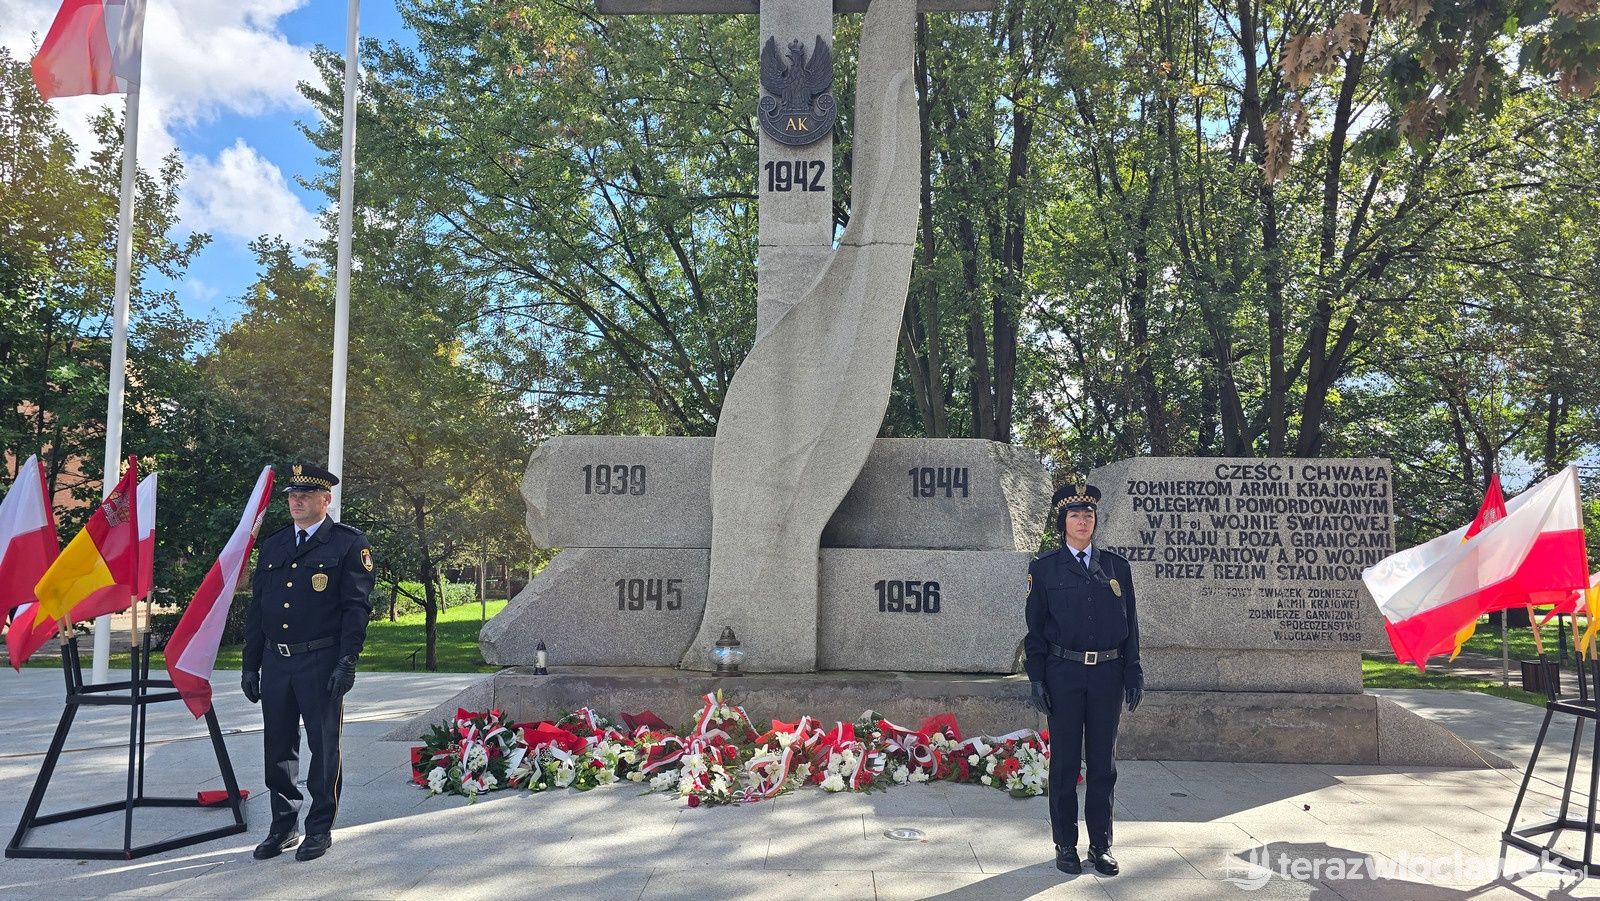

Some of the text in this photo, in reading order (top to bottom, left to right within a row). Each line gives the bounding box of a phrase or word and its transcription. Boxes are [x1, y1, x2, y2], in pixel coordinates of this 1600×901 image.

[785, 117, 809, 131] AK
[764, 160, 826, 192] 1942
[582, 464, 646, 496] 1939
[1215, 462, 1388, 481] CZEŚĆ I CHWAŁA
[908, 467, 969, 498] 1944
[1127, 478, 1388, 498] ŻOŁNIERZOM ARMII KRAJOWEJ
[1132, 496, 1388, 514] POLEGŁYM I POMORDOWANYM
[1146, 514, 1164, 529] W
[1209, 514, 1279, 530] WOJNIE
[1286, 513, 1391, 531] ŚWIATOWEJ
[1139, 530, 1391, 548] W KRAJU I POZA GRANICAMI
[1277, 549, 1289, 563] A
[1295, 549, 1319, 564] PO
[1155, 563, 1205, 579] PRZEZ
[1276, 565, 1374, 581] STALINOW
[615, 578, 682, 611] 1945
[874, 580, 940, 613] 1956
[1310, 599, 1360, 609] KRAJOWEJ
[1338, 632, 1361, 642] 1999
